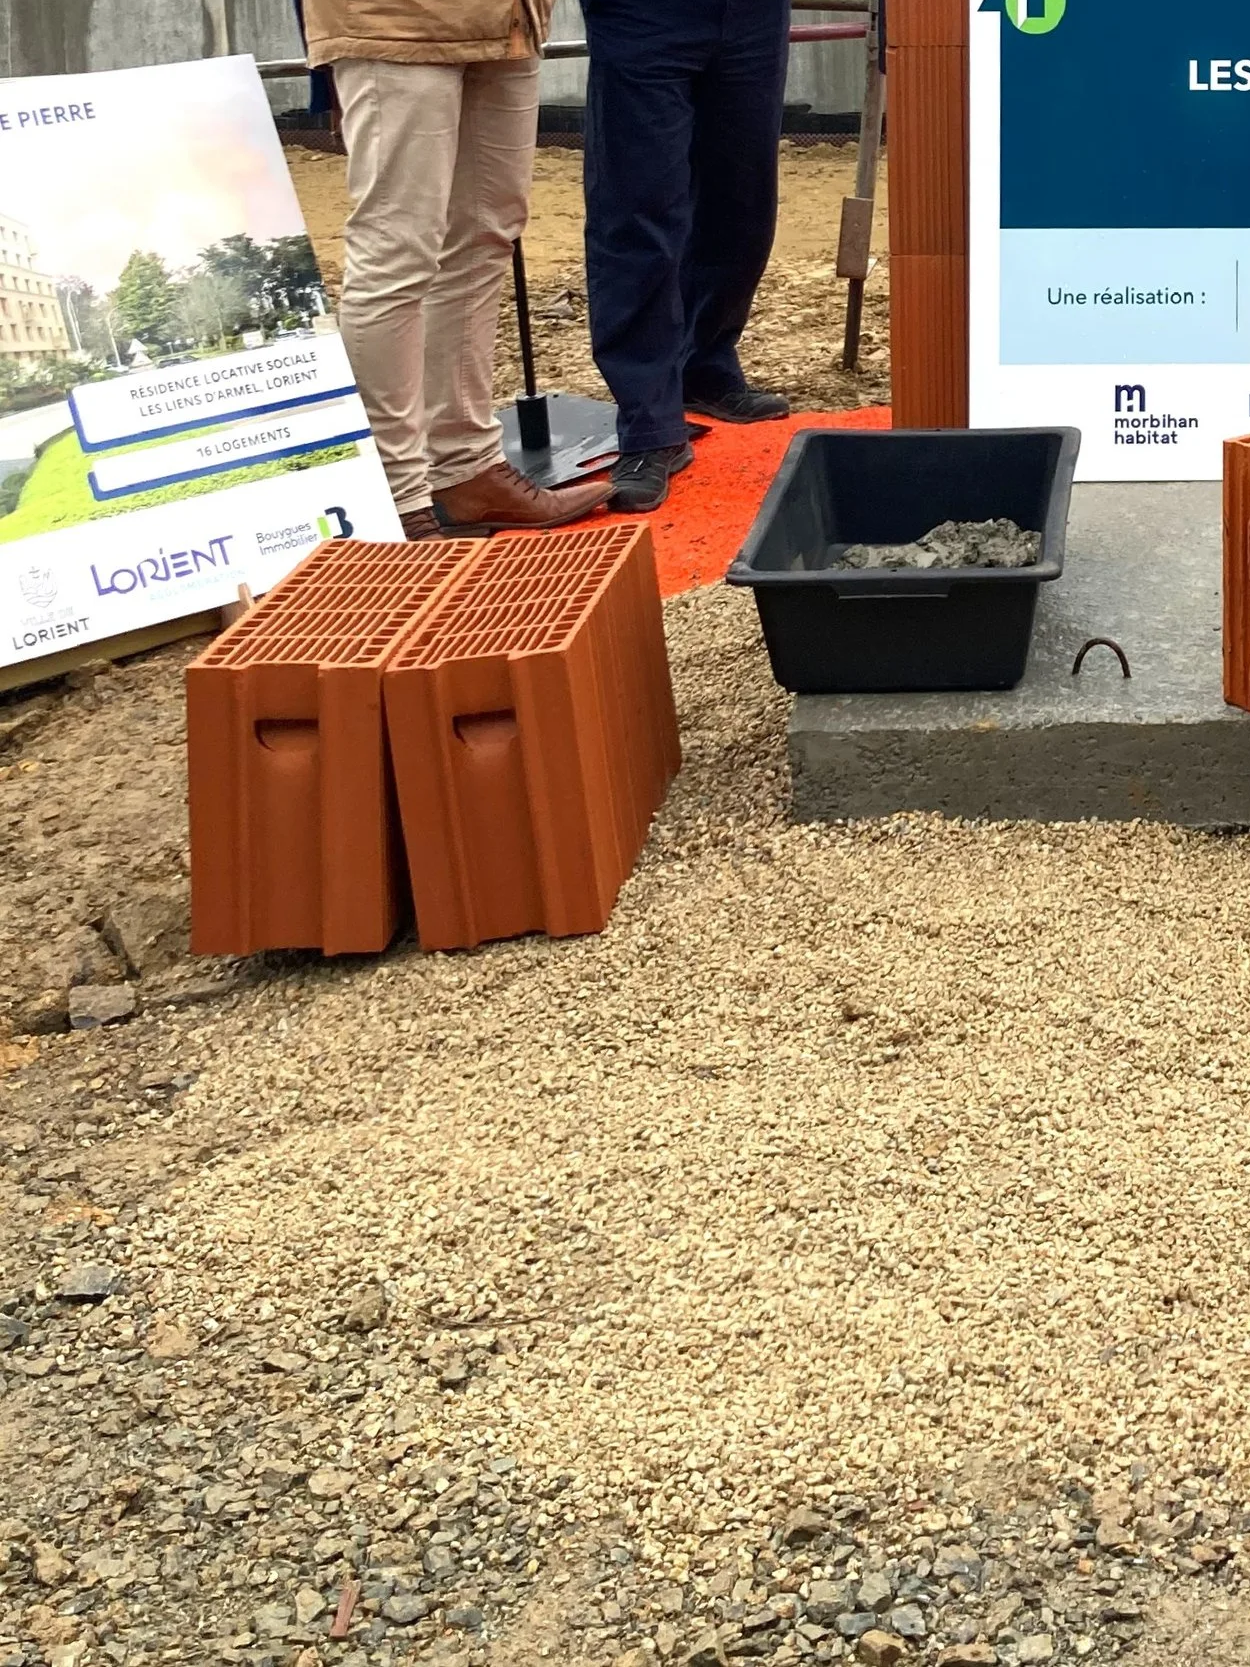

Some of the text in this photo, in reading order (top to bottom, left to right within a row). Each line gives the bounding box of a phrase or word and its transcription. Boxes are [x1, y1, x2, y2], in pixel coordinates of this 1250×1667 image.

[17, 102, 96, 128] PIERRE
[1047, 288, 1087, 305] Une
[1094, 286, 1194, 305] réalisation
[130, 351, 317, 400] RÉSIDENCE LOCATIVE SOCIALE
[140, 403, 162, 417] LES
[167, 395, 202, 412] LIENS
[266, 369, 319, 390] LORIENT
[1114, 415, 1198, 429] morbihan
[197, 427, 291, 458] 16 LOGEMENTS
[1114, 431, 1177, 445] habitat
[256, 522, 311, 543] Bouygues
[259, 533, 318, 555] Immobilier
[12, 617, 90, 650] LORIENT
